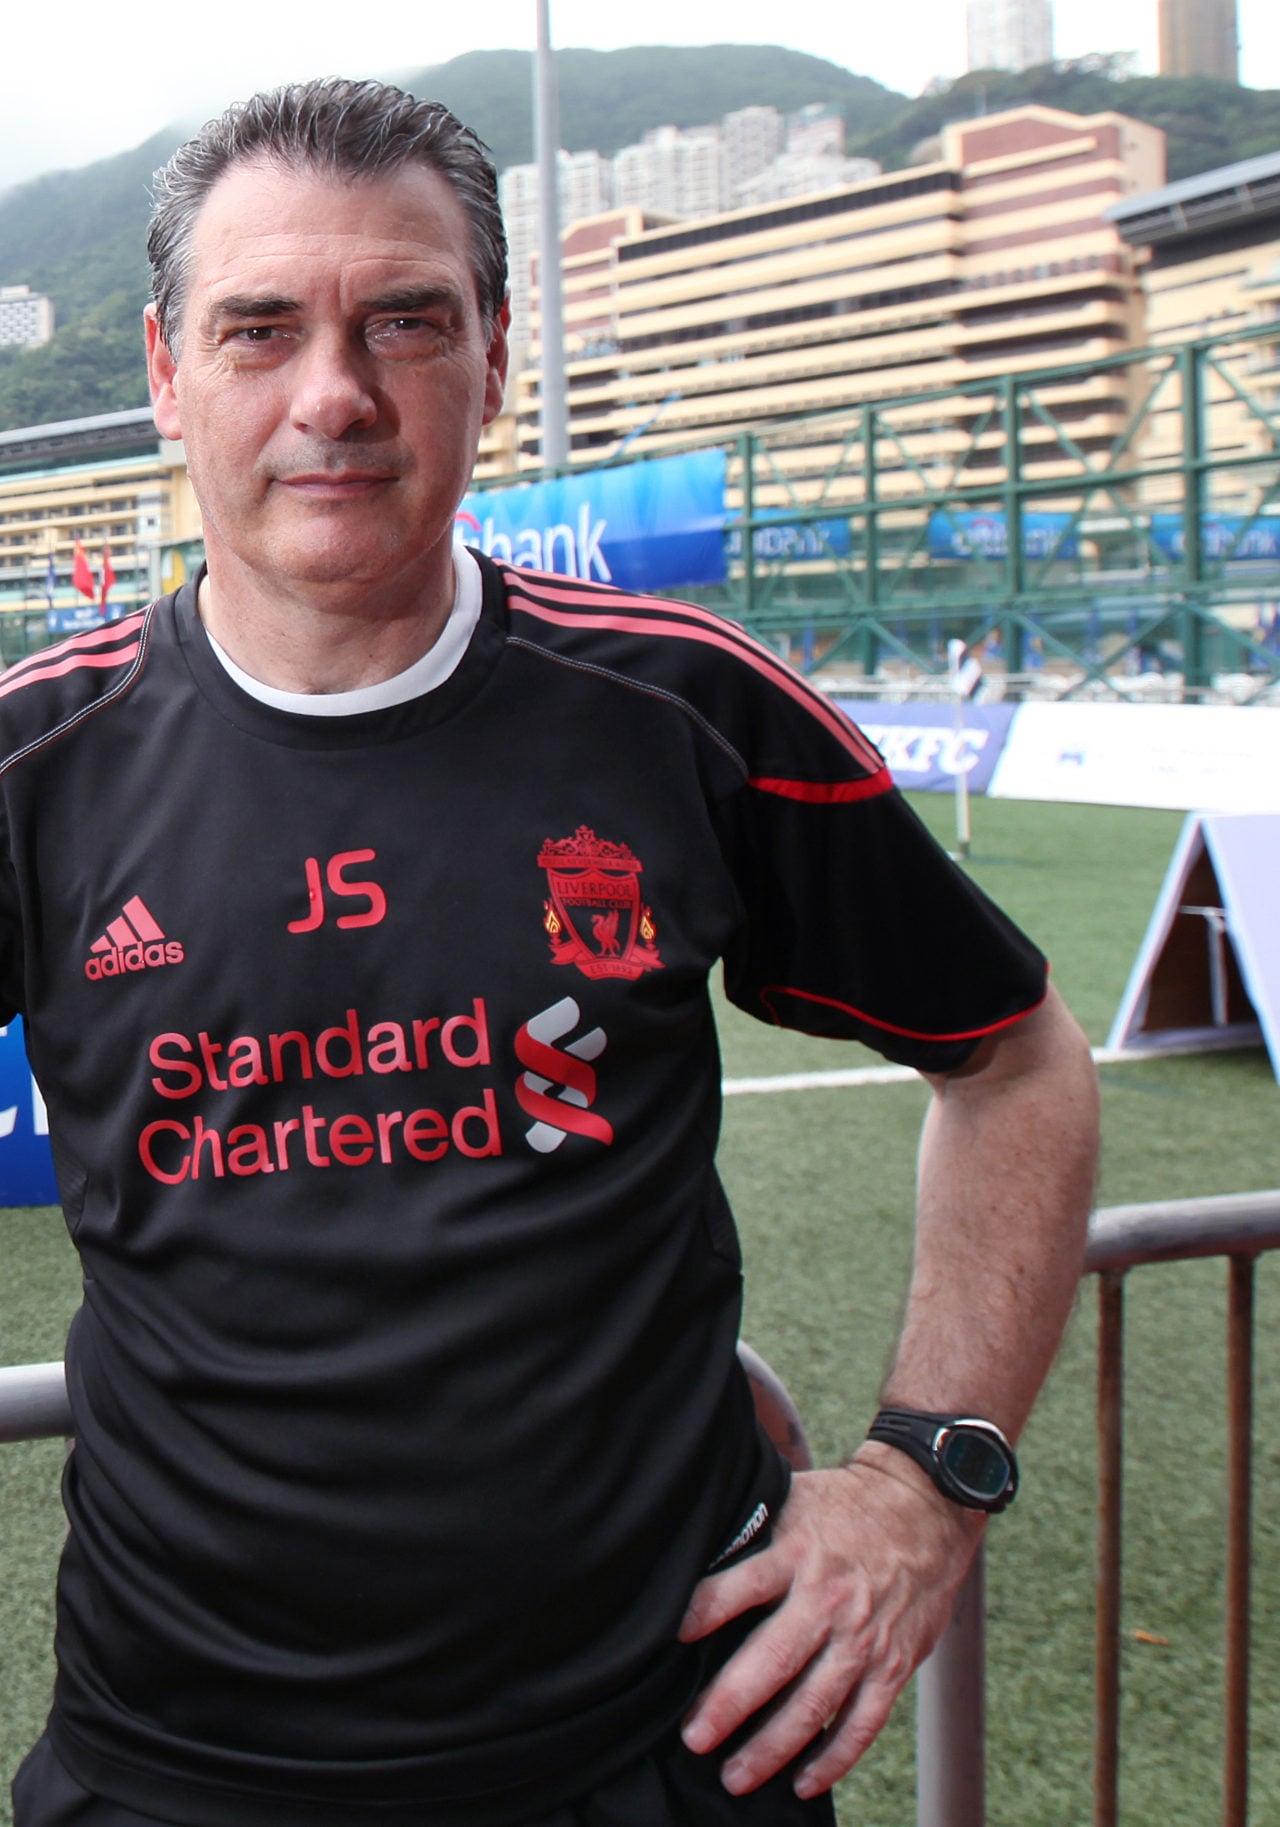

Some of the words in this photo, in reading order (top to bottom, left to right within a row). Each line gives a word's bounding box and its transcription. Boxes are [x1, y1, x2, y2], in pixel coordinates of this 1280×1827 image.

[452, 501, 612, 583] bank
[287, 848, 387, 934] JS
[556, 881, 634, 898] LIVERPOOL
[84, 941, 186, 981] adidas
[149, 997, 492, 1100] Standard
[138, 1088, 502, 1186] Chartered
